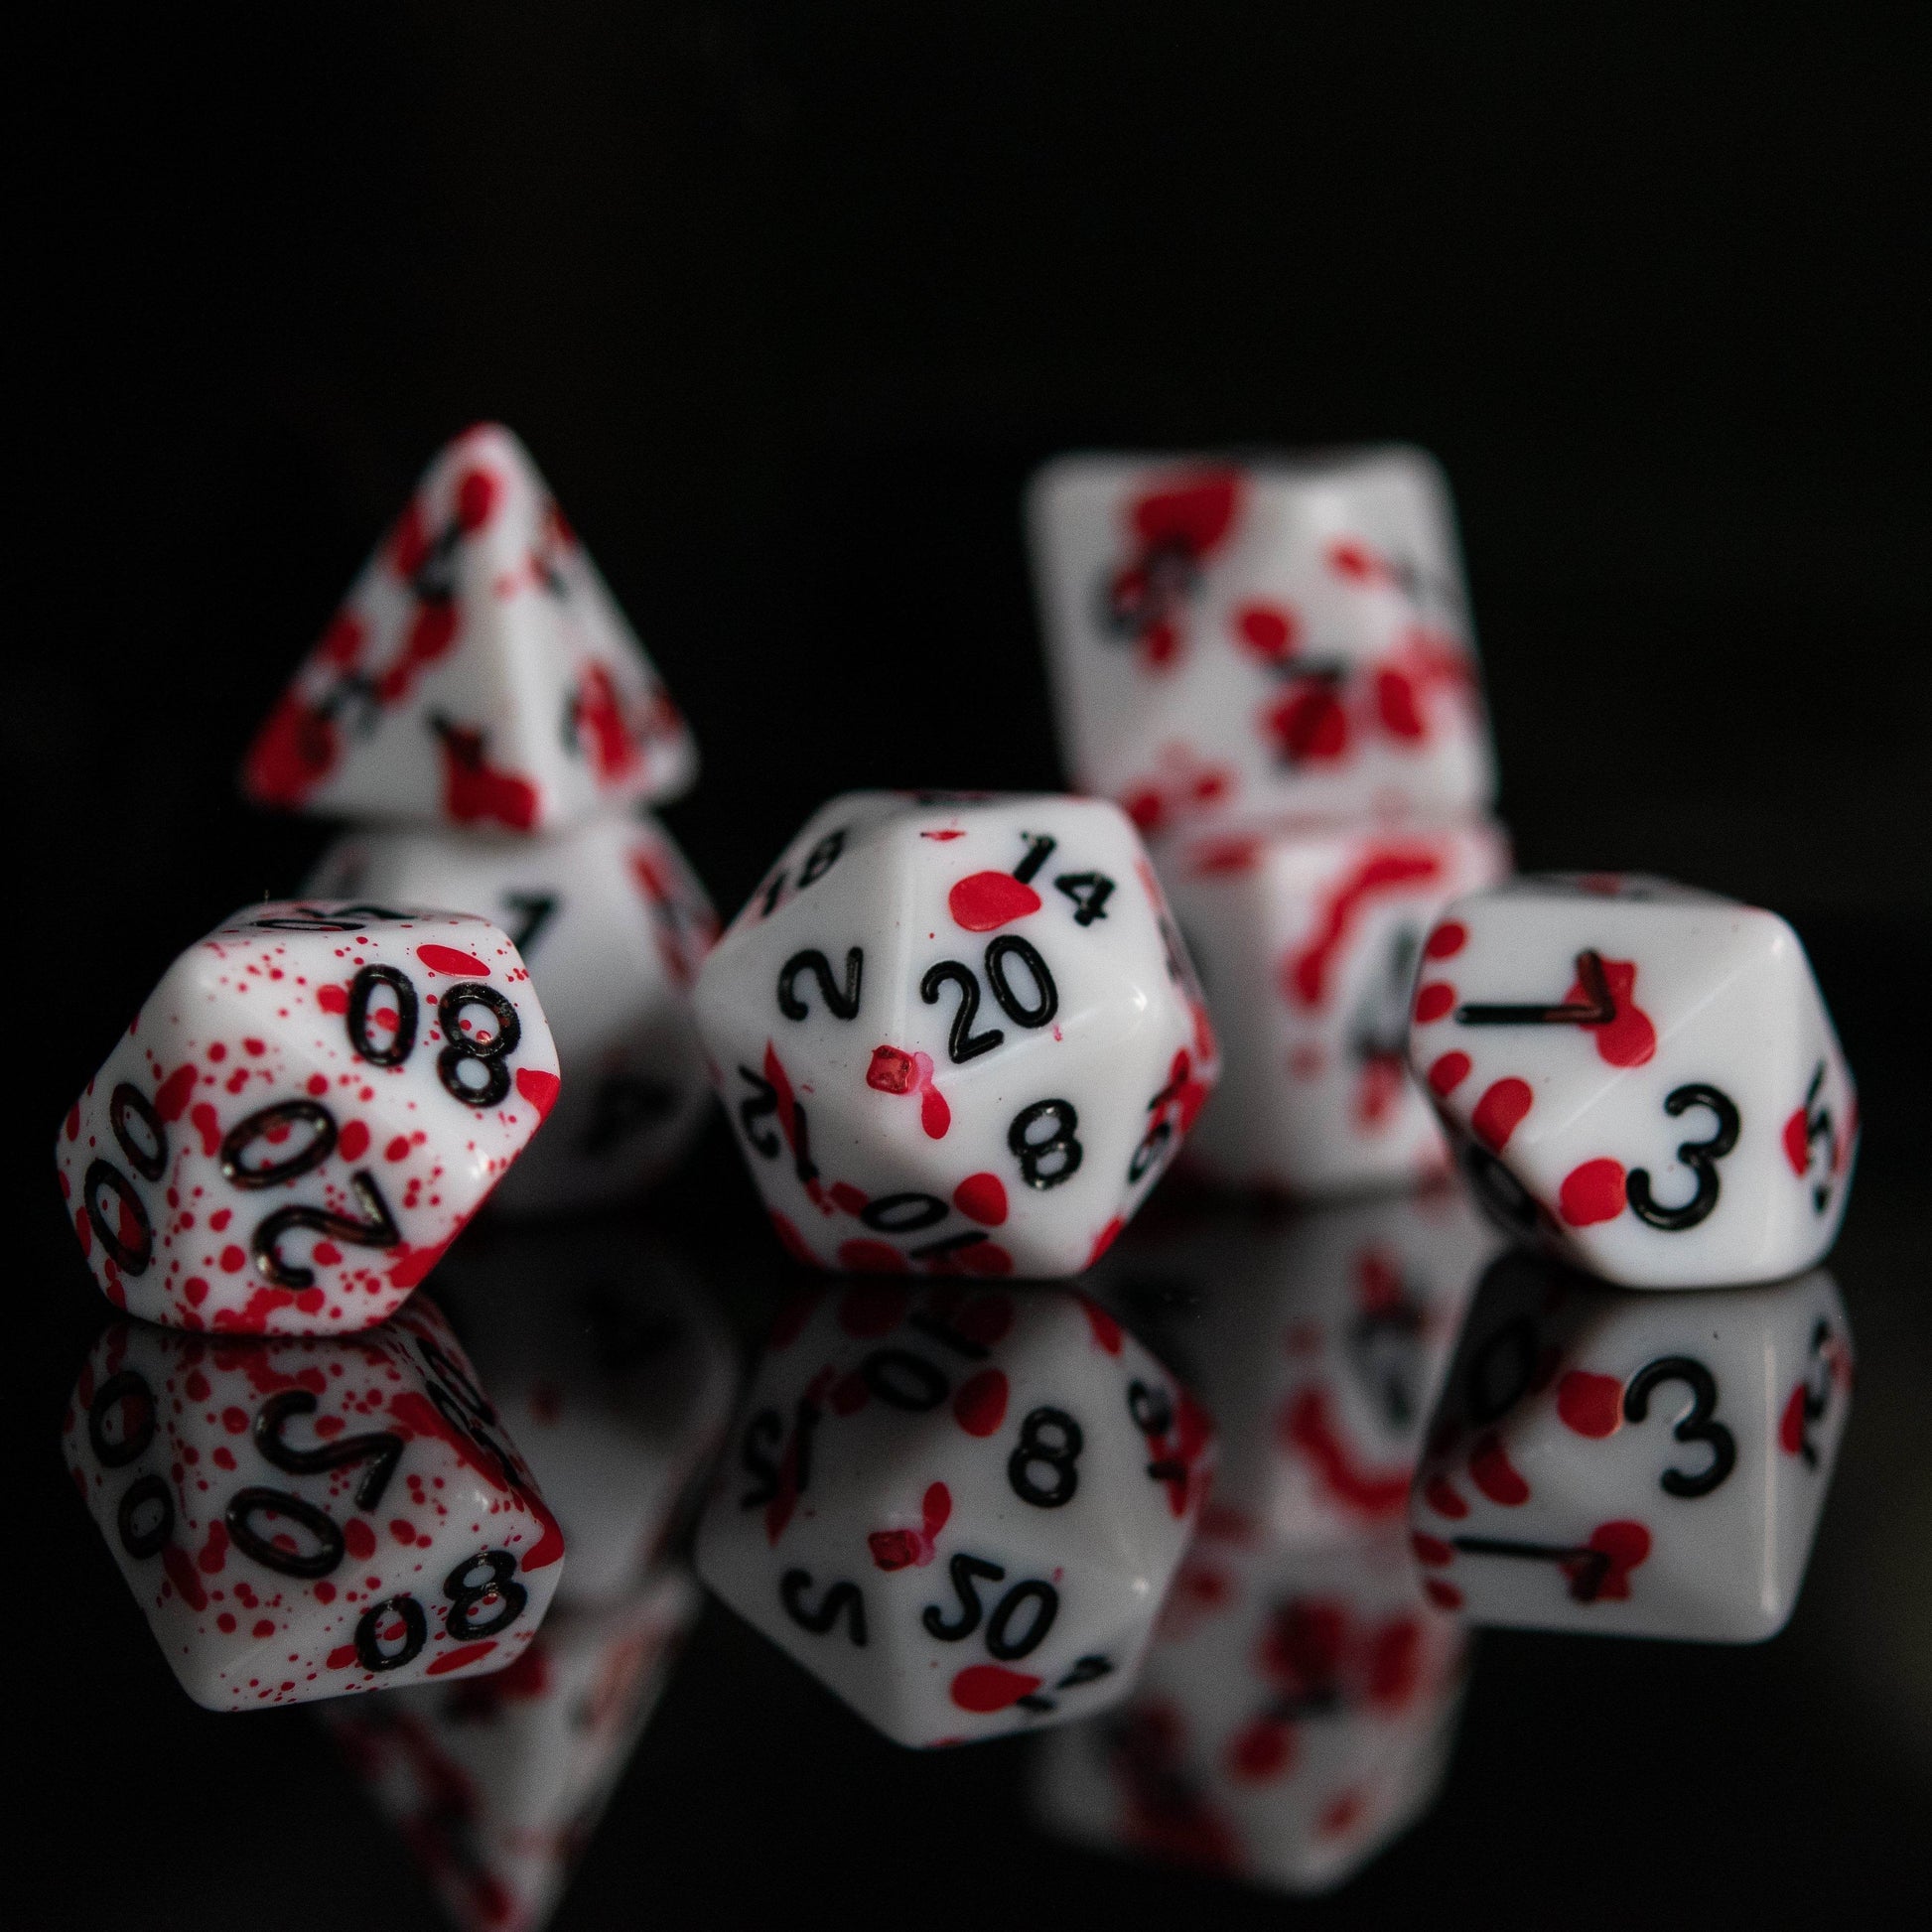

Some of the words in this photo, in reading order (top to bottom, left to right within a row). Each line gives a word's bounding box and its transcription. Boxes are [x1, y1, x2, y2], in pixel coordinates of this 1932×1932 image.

[1012, 830, 1109, 926] 14
[346, 964, 520, 1108] 80
[777, 946, 864, 1021] 2
[919, 934, 1058, 1063] 20
[84, 1082, 169, 1277] 00
[220, 1099, 401, 1290] 20
[1008, 1098, 1083, 1190] 8
[1626, 1083, 1740, 1231] 3
